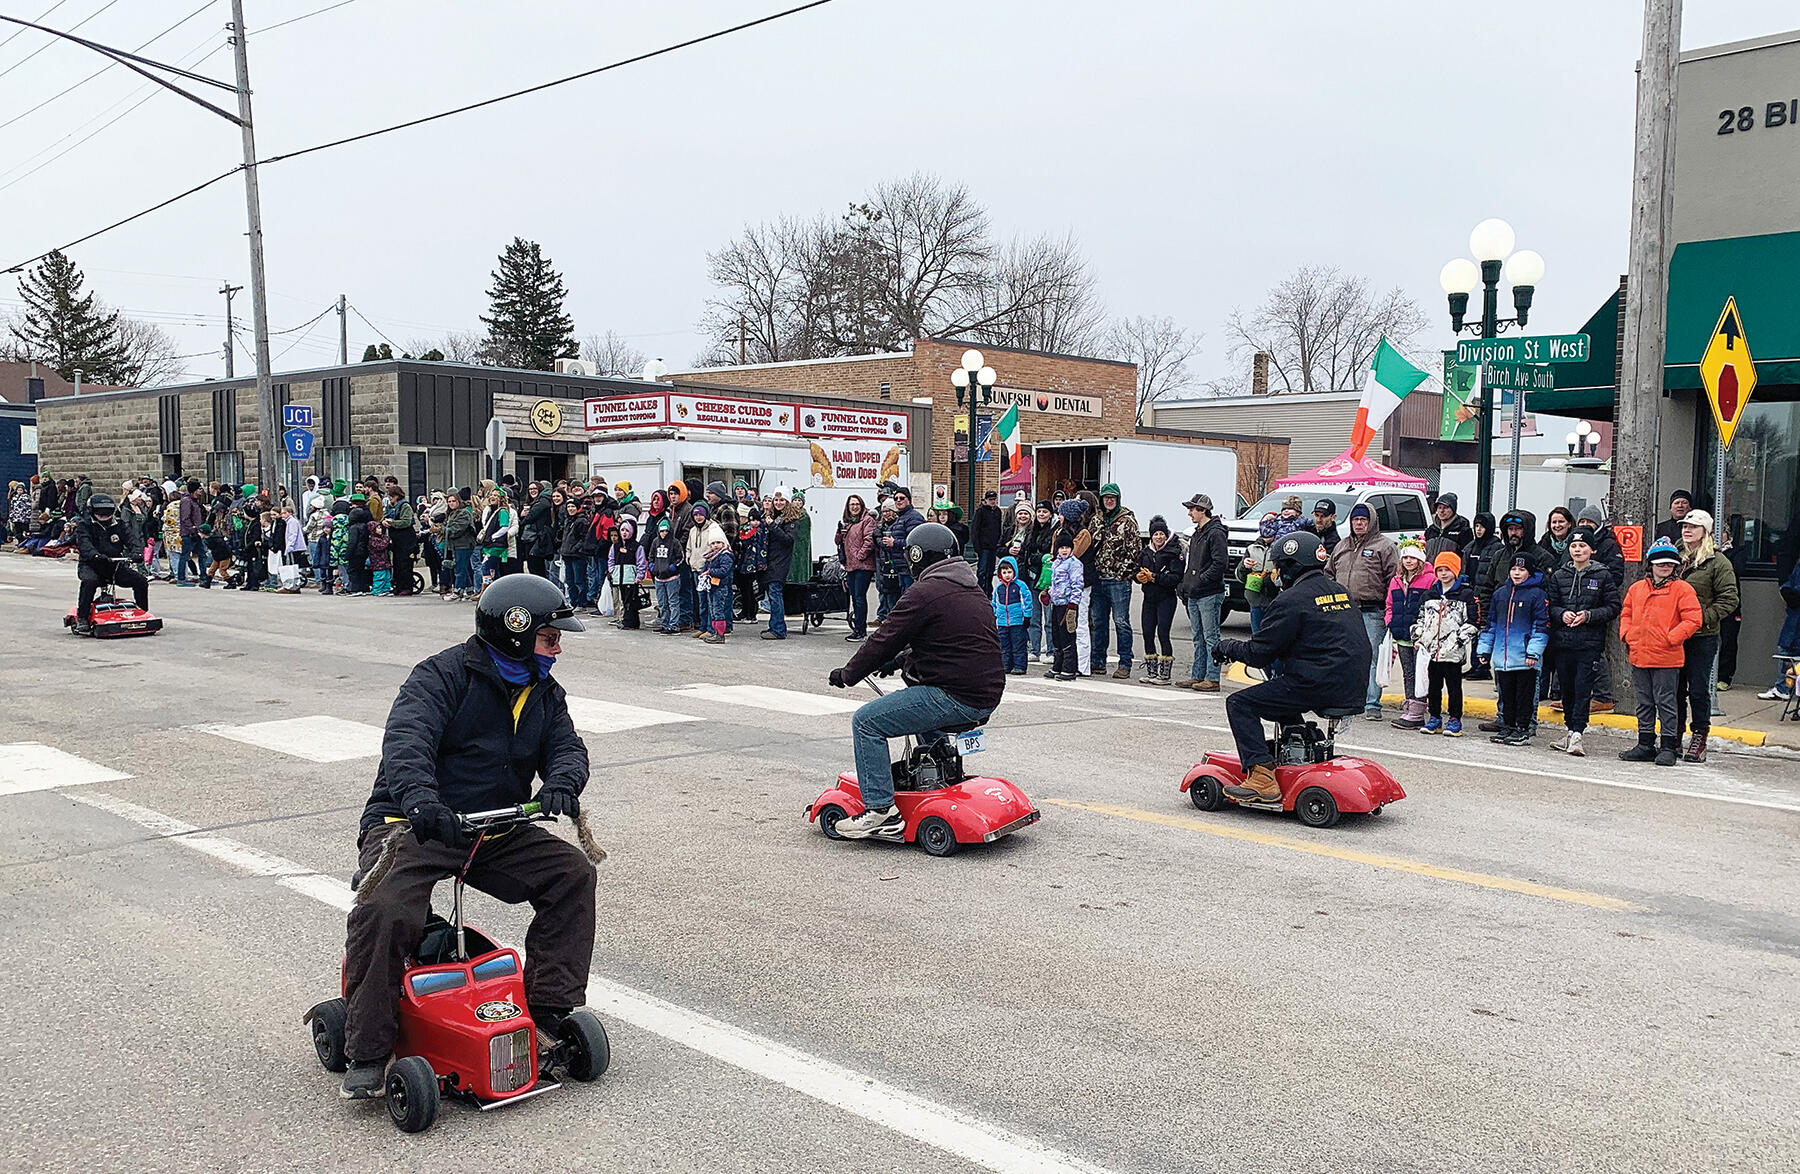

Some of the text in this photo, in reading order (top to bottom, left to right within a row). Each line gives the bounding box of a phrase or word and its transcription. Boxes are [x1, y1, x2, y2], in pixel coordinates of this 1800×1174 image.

[1717, 106, 1755, 135] 28
[1459, 338, 1584, 362] Division St West
[1487, 365, 1554, 389] Birch Ave South
[593, 400, 658, 415] FUNNEL CAKES
[695, 402, 773, 417] CHEESE CURDS
[1054, 397, 1092, 413] DENTAL
[286, 409, 310, 423] JCT
[599, 414, 629, 423] DIFFERENT
[629, 412, 656, 421] TOPPINGS
[697, 414, 729, 424] REGULAR
[738, 417, 771, 426] JALAPENO
[821, 413, 889, 426] FUNNEL CAKES
[827, 424, 859, 433] DIFFERENT
[860, 426, 888, 435] TOPPINGS
[295, 438, 304, 451] 8
[832, 450, 881, 463] HAND DIPPED
[836, 466, 877, 479] CORN DOGS
[964, 737, 981, 751] BPS
